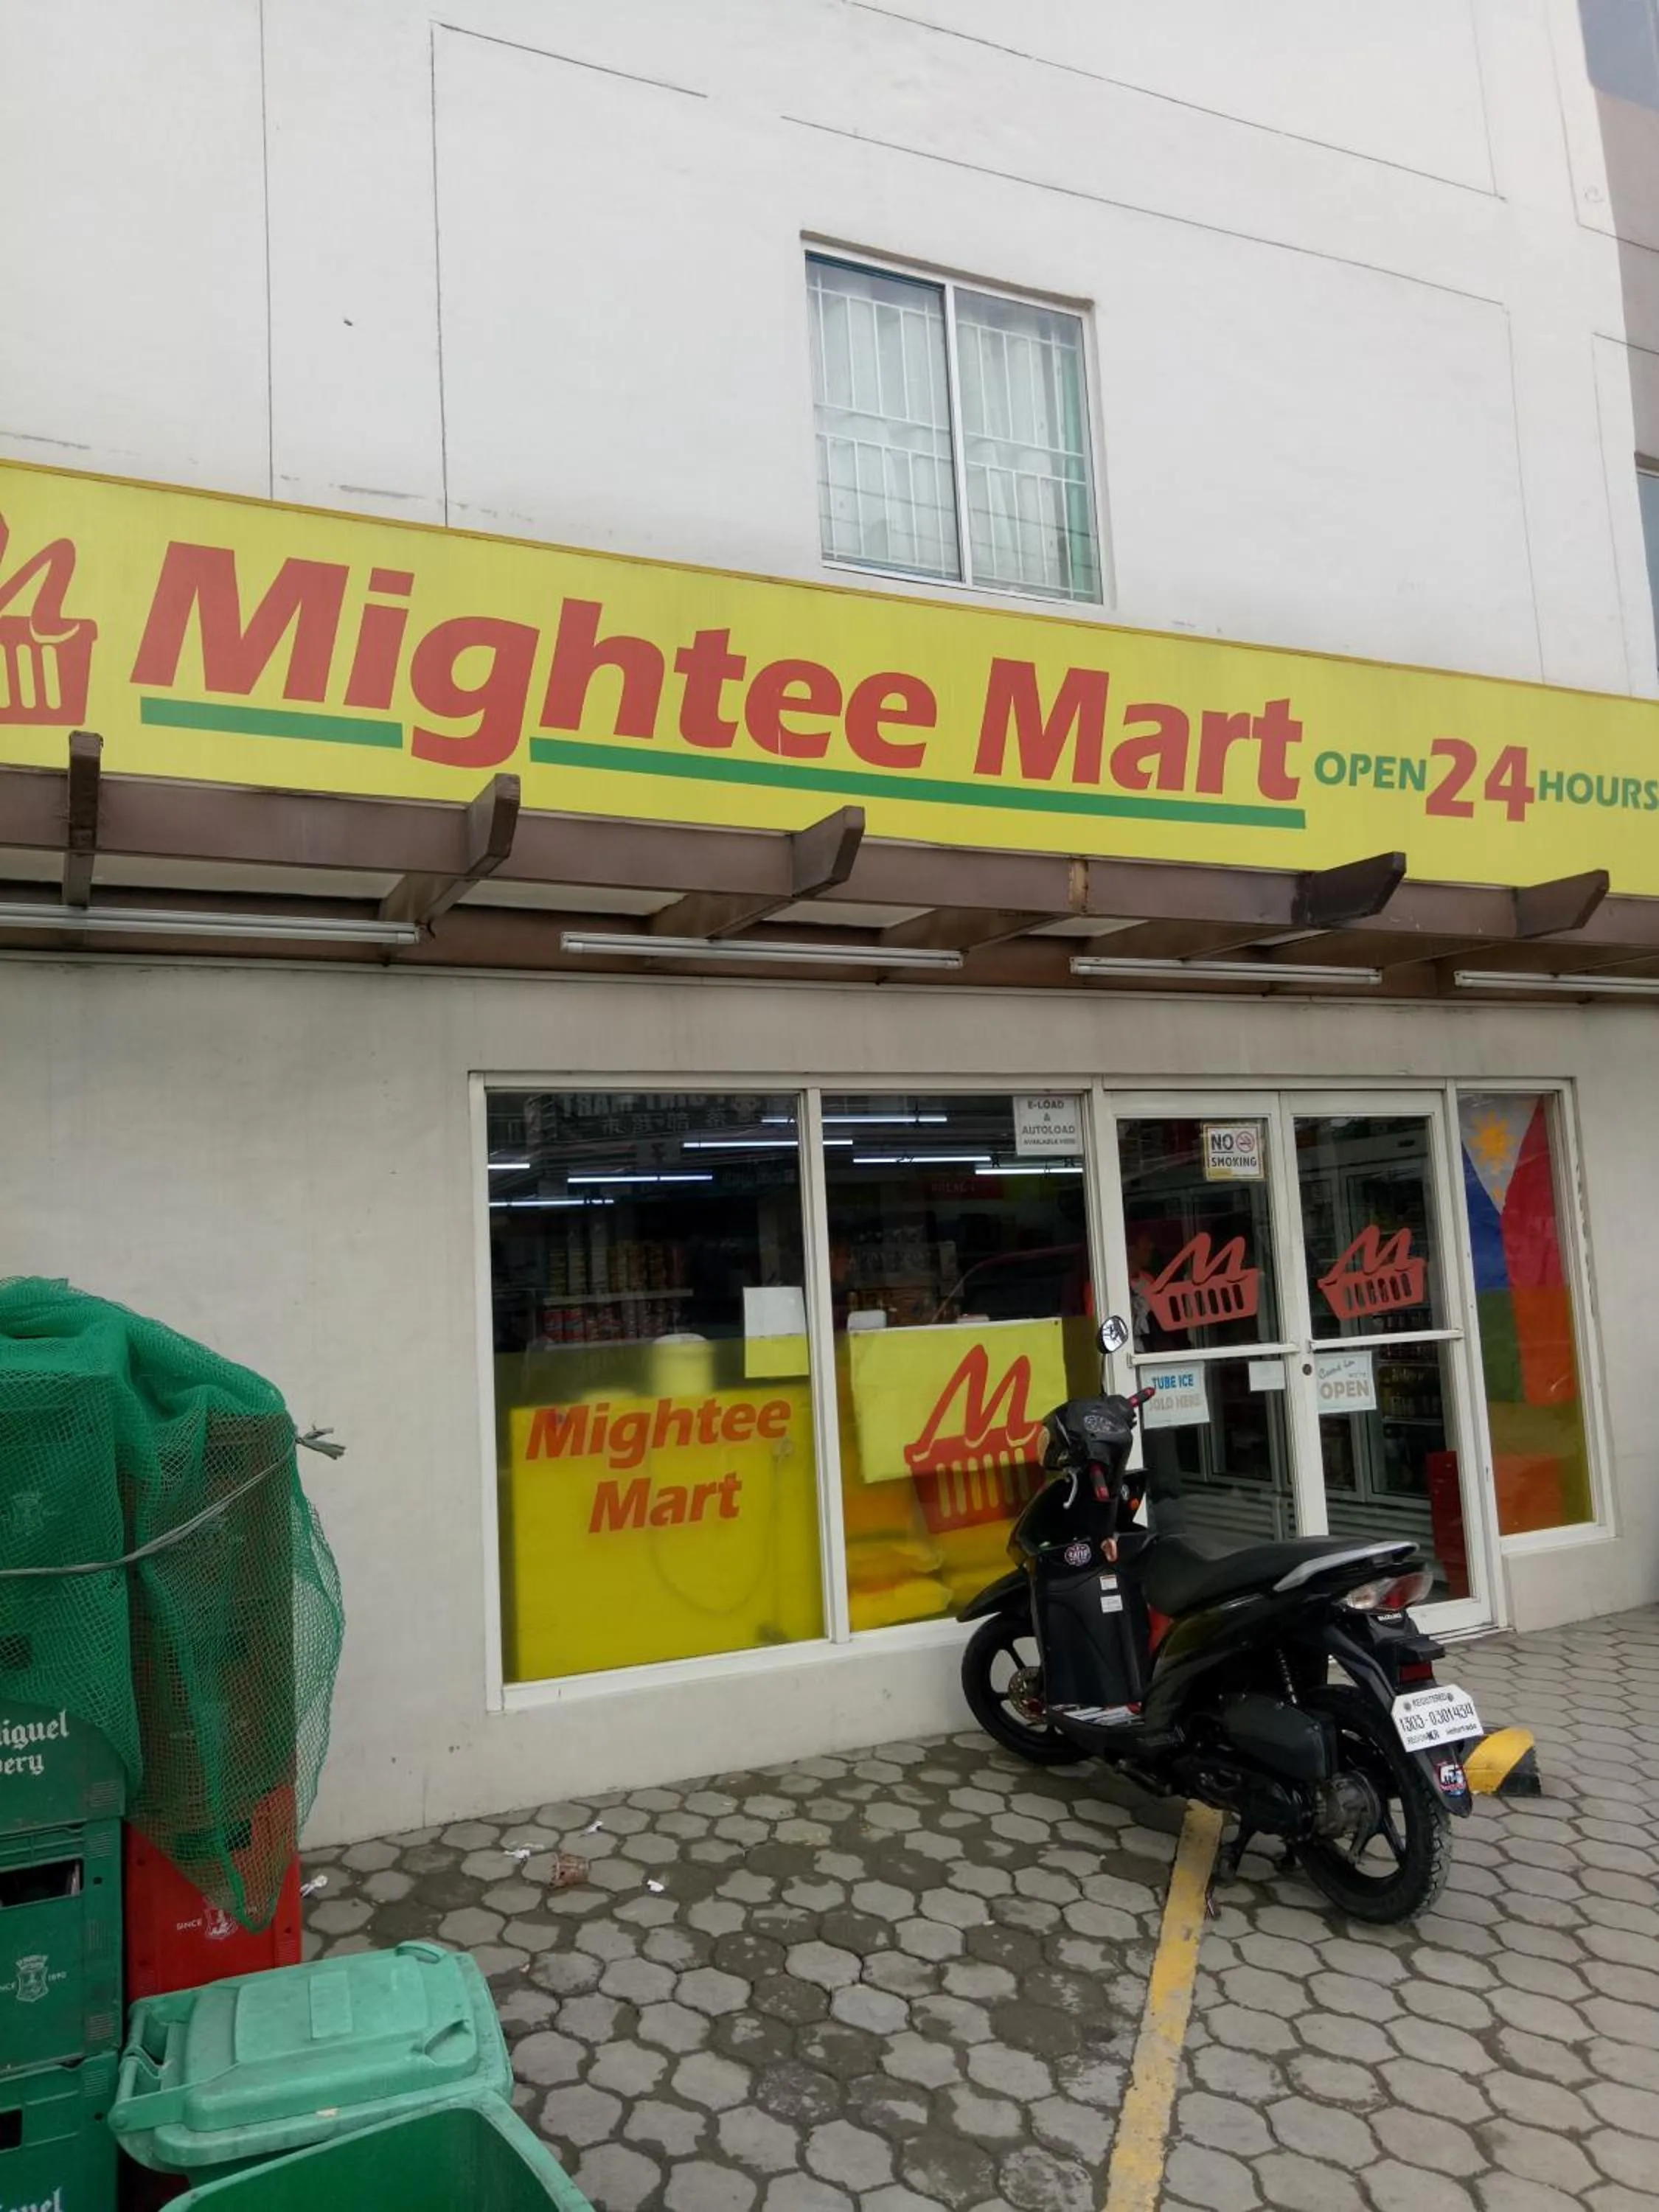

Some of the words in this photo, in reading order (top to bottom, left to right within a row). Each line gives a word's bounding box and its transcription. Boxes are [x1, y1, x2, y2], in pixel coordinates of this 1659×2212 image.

[130, 540, 937, 769] Mightee
[973, 656, 1303, 801] Mart
[1314, 751, 1427, 791] OPEN
[1425, 738, 1534, 822] 24
[1539, 770, 1659, 810] HOURS
[1027, 1099, 1065, 1110] E-LOAD
[1021, 1125, 1076, 1135] AUTOLOAD
[1211, 1133, 1234, 1151] NO
[1211, 1156, 1257, 1168] SMOKING
[1151, 1374, 1177, 1390] TUBE
[1178, 1374, 1194, 1388] ICE
[1321, 1380, 1369, 1400] OPEN
[526, 1398, 792, 1469] Mightee
[588, 1472, 742, 1534] Mart
[0, 1709, 70, 1750] iguel
